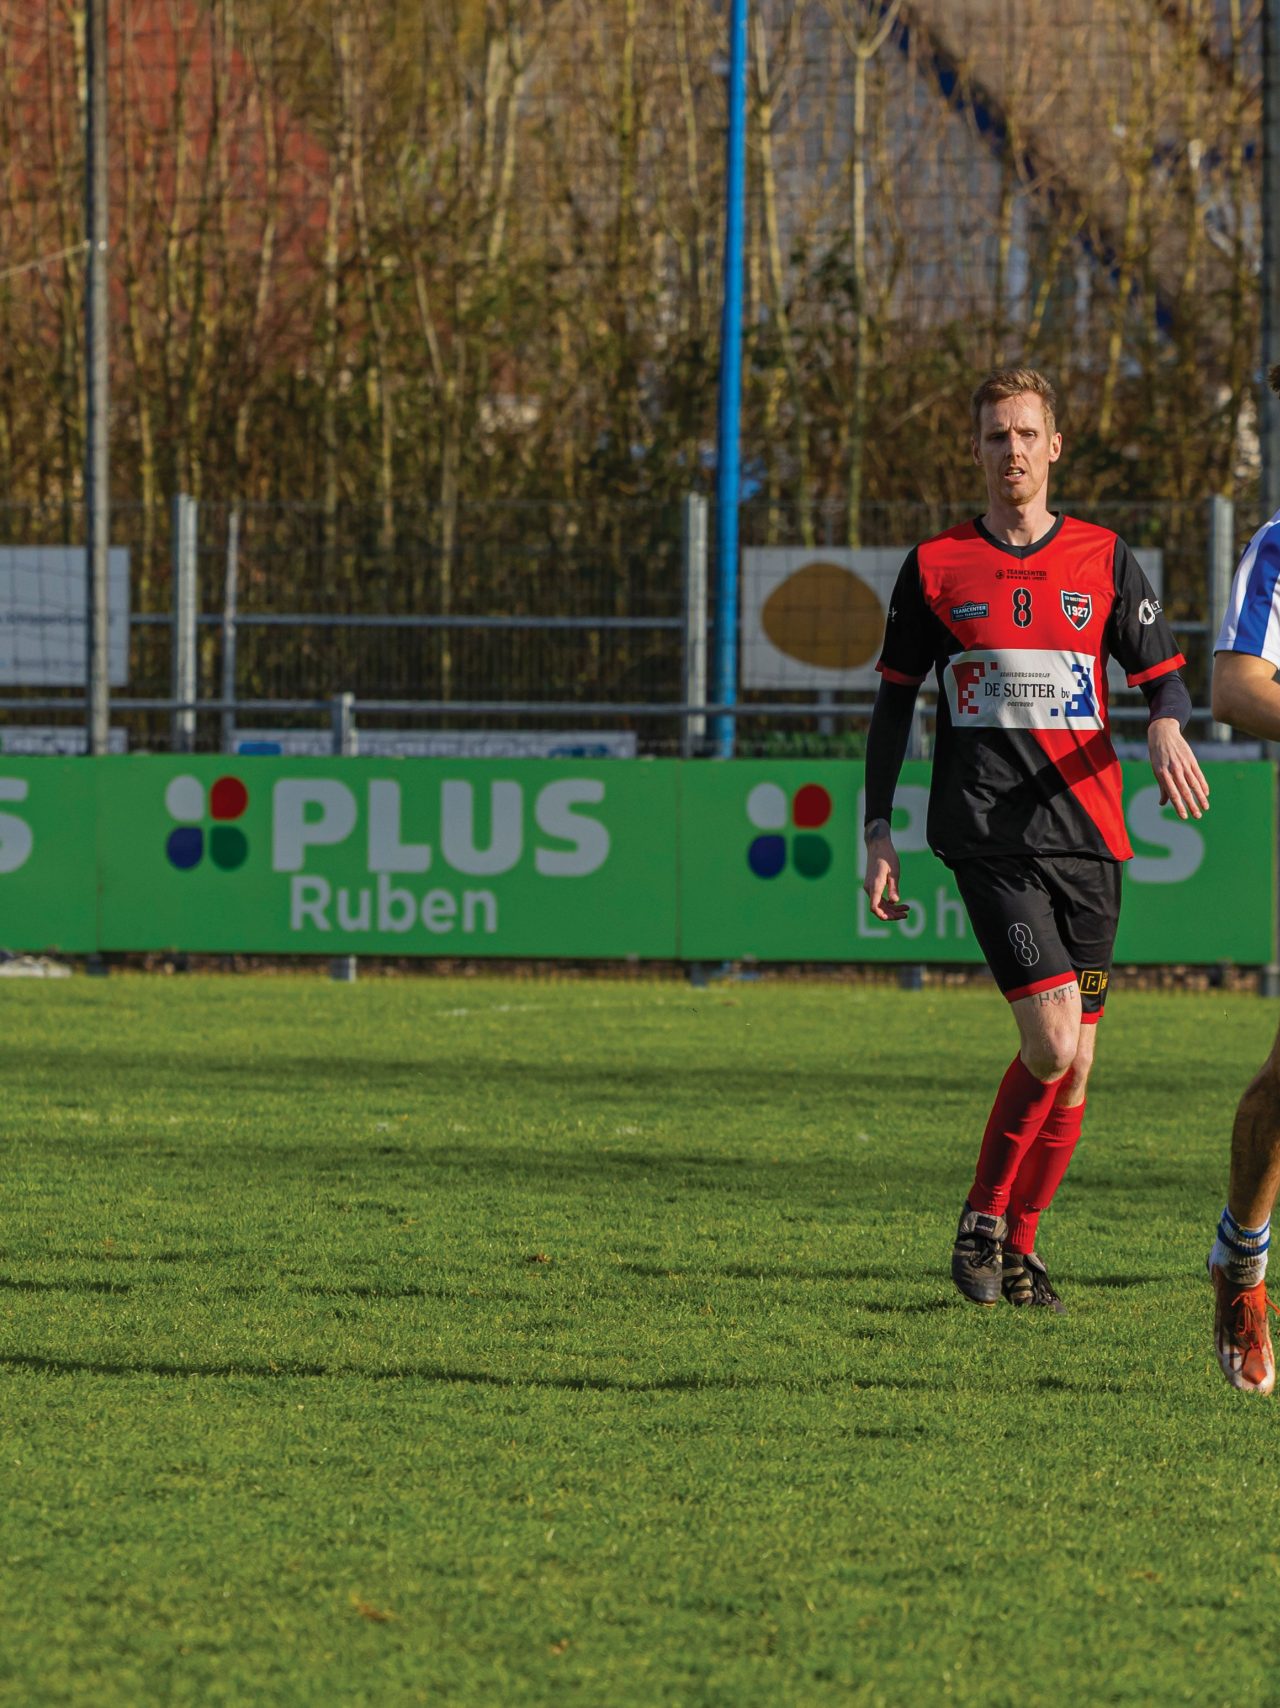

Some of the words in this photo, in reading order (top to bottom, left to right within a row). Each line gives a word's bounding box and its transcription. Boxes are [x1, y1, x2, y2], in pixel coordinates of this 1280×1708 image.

[1012, 587, 1033, 628] 8
[1066, 605, 1089, 618] 1927
[984, 682, 1000, 697] DE
[1003, 683, 1056, 699] SUTTER
[272, 778, 611, 877] PLUS
[289, 875, 498, 934] Ruben
[1008, 922, 1040, 967] 8
